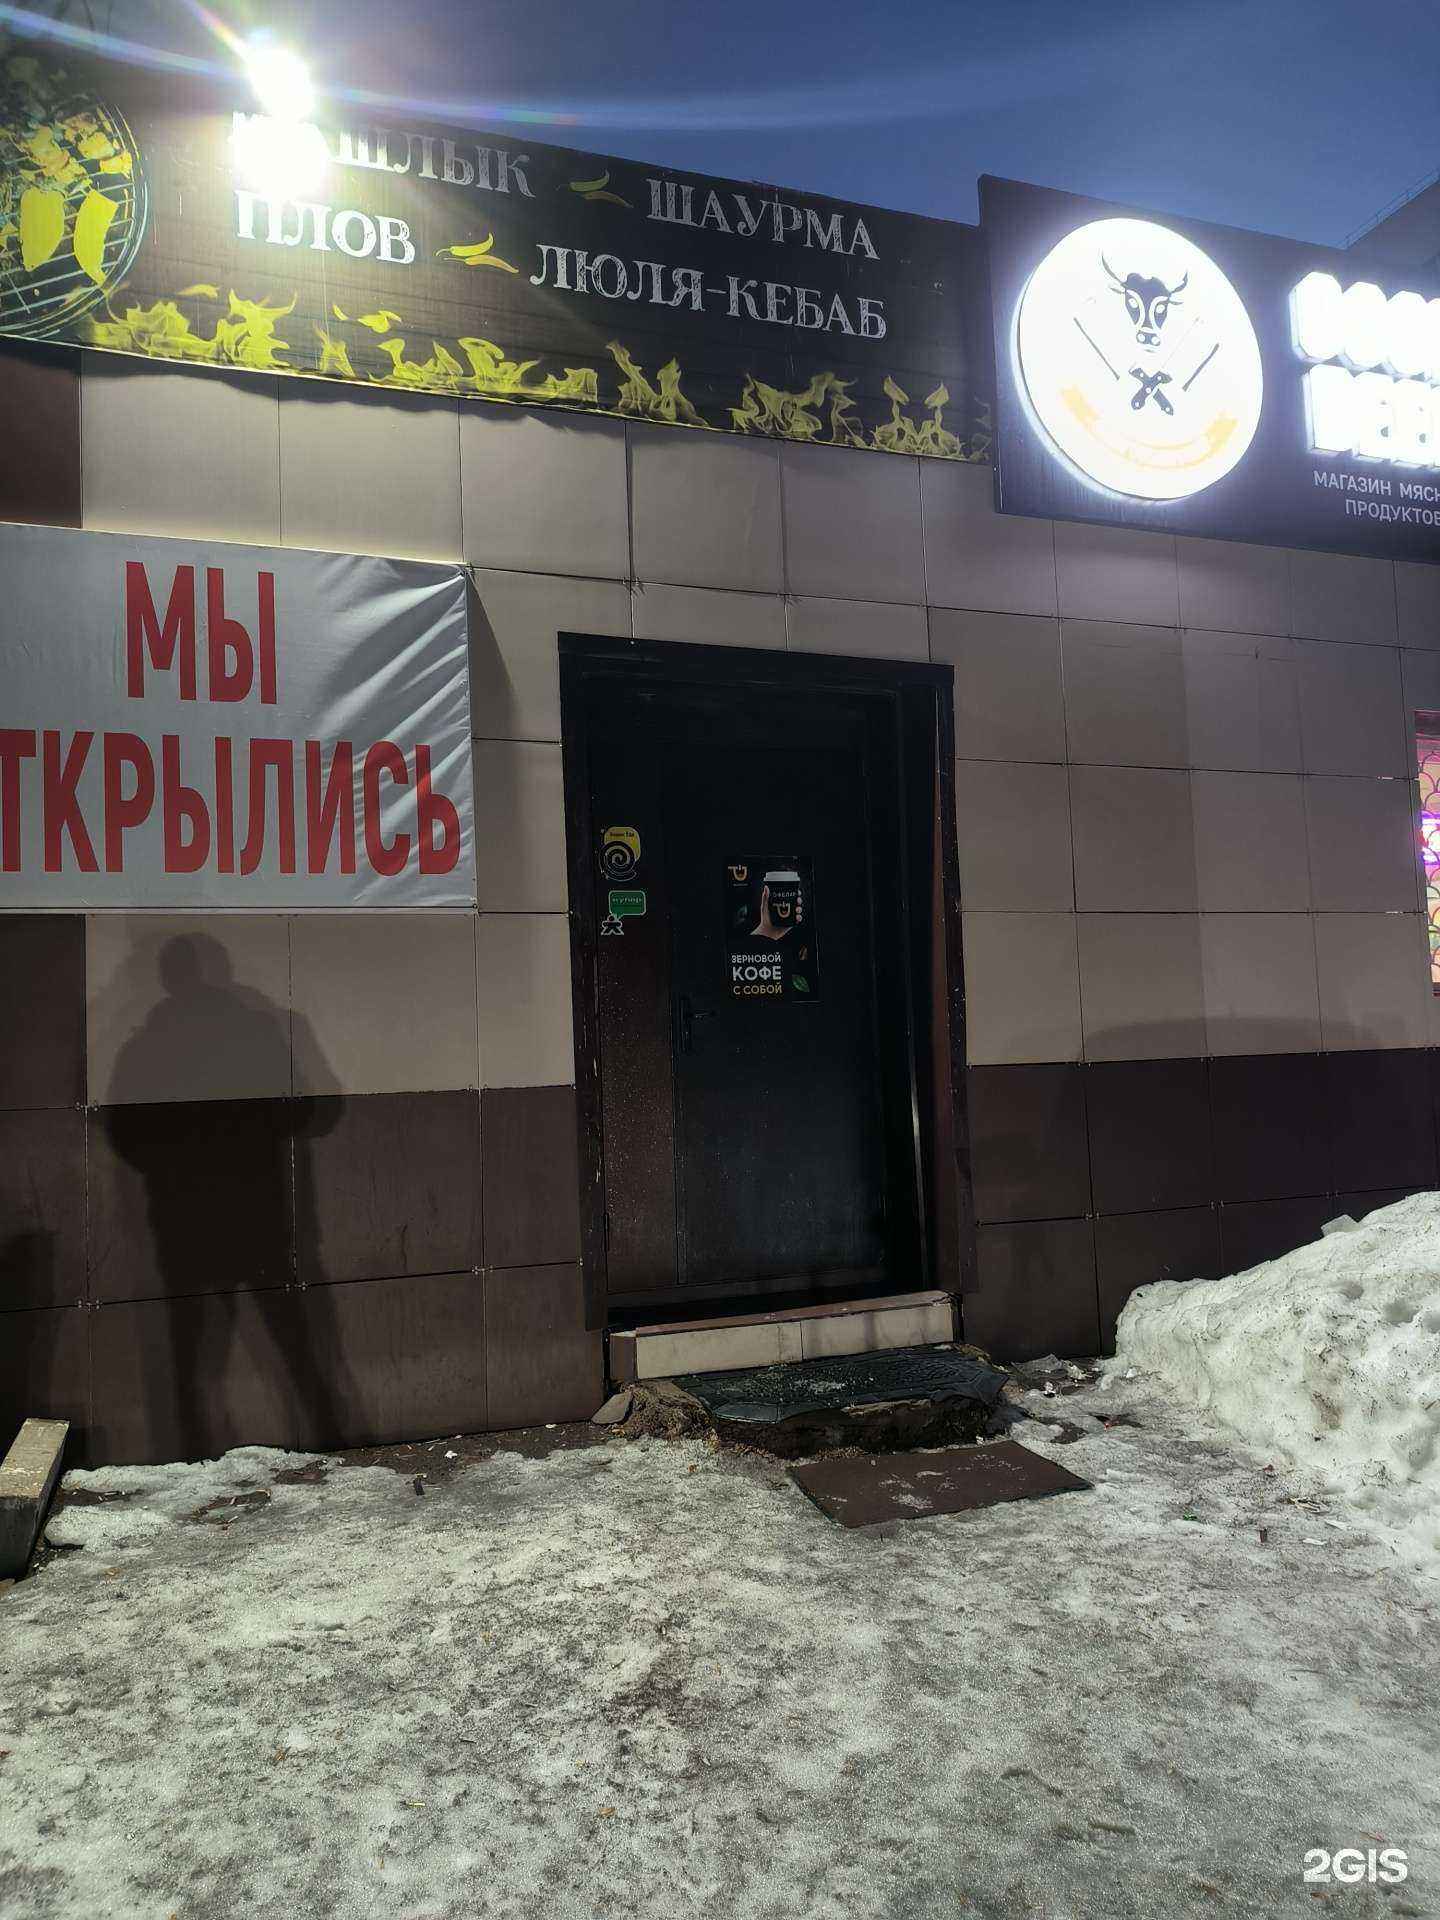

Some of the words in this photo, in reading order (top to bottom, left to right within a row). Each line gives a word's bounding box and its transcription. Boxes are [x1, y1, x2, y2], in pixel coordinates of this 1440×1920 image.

[233, 190, 417, 265] ПЛОВ
[645, 178, 881, 261] ШАУРМА
[529, 243, 888, 341] ЛЮЛЯ-КЕБАБ
[1313, 470, 1392, 496] МАГАЗИН
[125, 560, 278, 705] МЫ
[731, 951, 783, 964] ЗЕРНОВОЙ
[732, 965, 783, 982] КОФЕ
[733, 985, 741, 995] С
[743, 982, 784, 995] СОБОЙ
